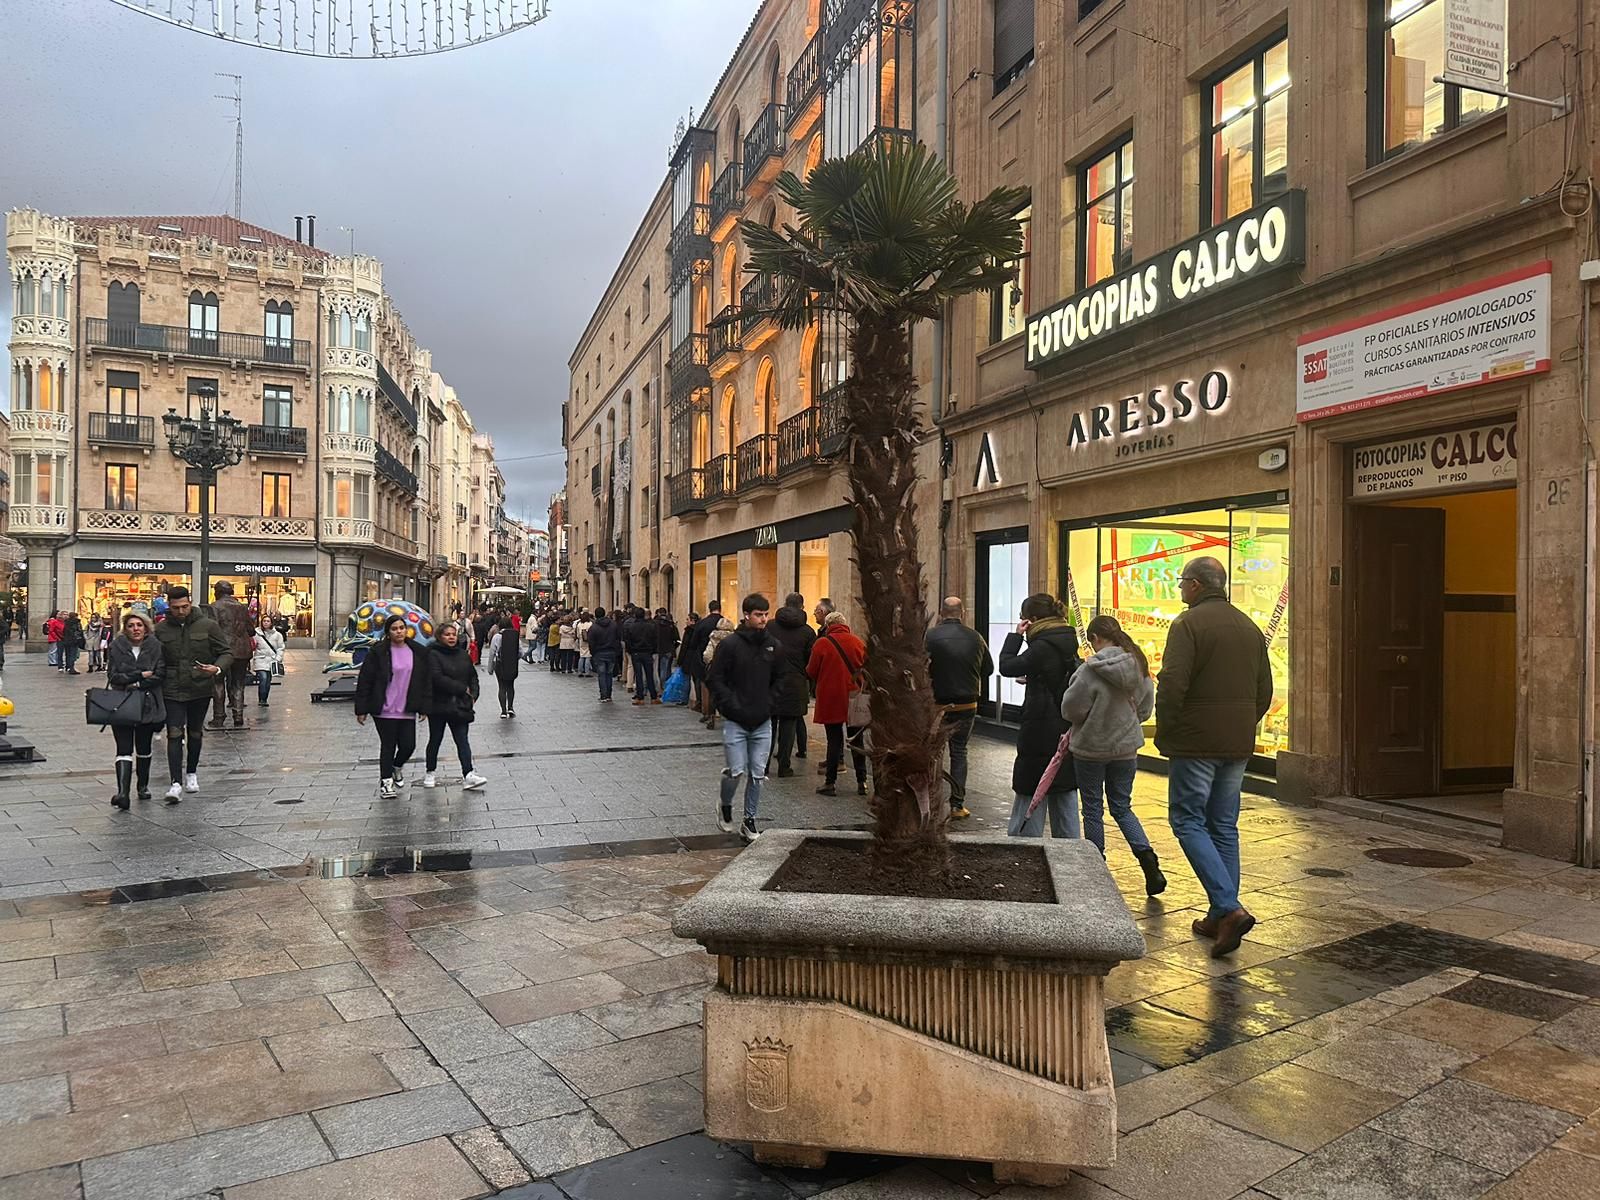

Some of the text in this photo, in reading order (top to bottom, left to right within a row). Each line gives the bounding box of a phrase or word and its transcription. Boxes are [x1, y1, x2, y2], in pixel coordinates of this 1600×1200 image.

[1027, 206, 1286, 362] FOTOCOPIAS CALCO
[1364, 335, 1376, 347] FP
[1378, 320, 1429, 343] OFICIALES
[1432, 317, 1440, 328] Y
[1364, 309, 1536, 363] CURSOS SANITARIOS INTENSIVOS
[1364, 361, 1404, 378] PRÁCTICAS
[1406, 345, 1470, 368] GARANTIZADAS
[1470, 341, 1489, 353] POR
[1489, 329, 1536, 348] CONTRATO
[1304, 358, 1327, 376] ESSAT
[1066, 371, 1228, 447] ARESSO
[1115, 435, 1175, 458] JOYERÍAS
[1355, 441, 1427, 470] FOTOCOPIAS
[1358, 467, 1424, 484] REPRODUCCION
[1450, 472, 1468, 482] PISO
[1366, 478, 1414, 492] DE PLANOS
[754, 525, 778, 547] ZARA
[103, 561, 165, 570] SPRINGFIELD
[234, 564, 291, 573] SPRINGFIELD
[1116, 609, 1131, 622] 80%
[1133, 613, 1146, 625] DTO
[1267, 604, 1285, 633] HASTA
